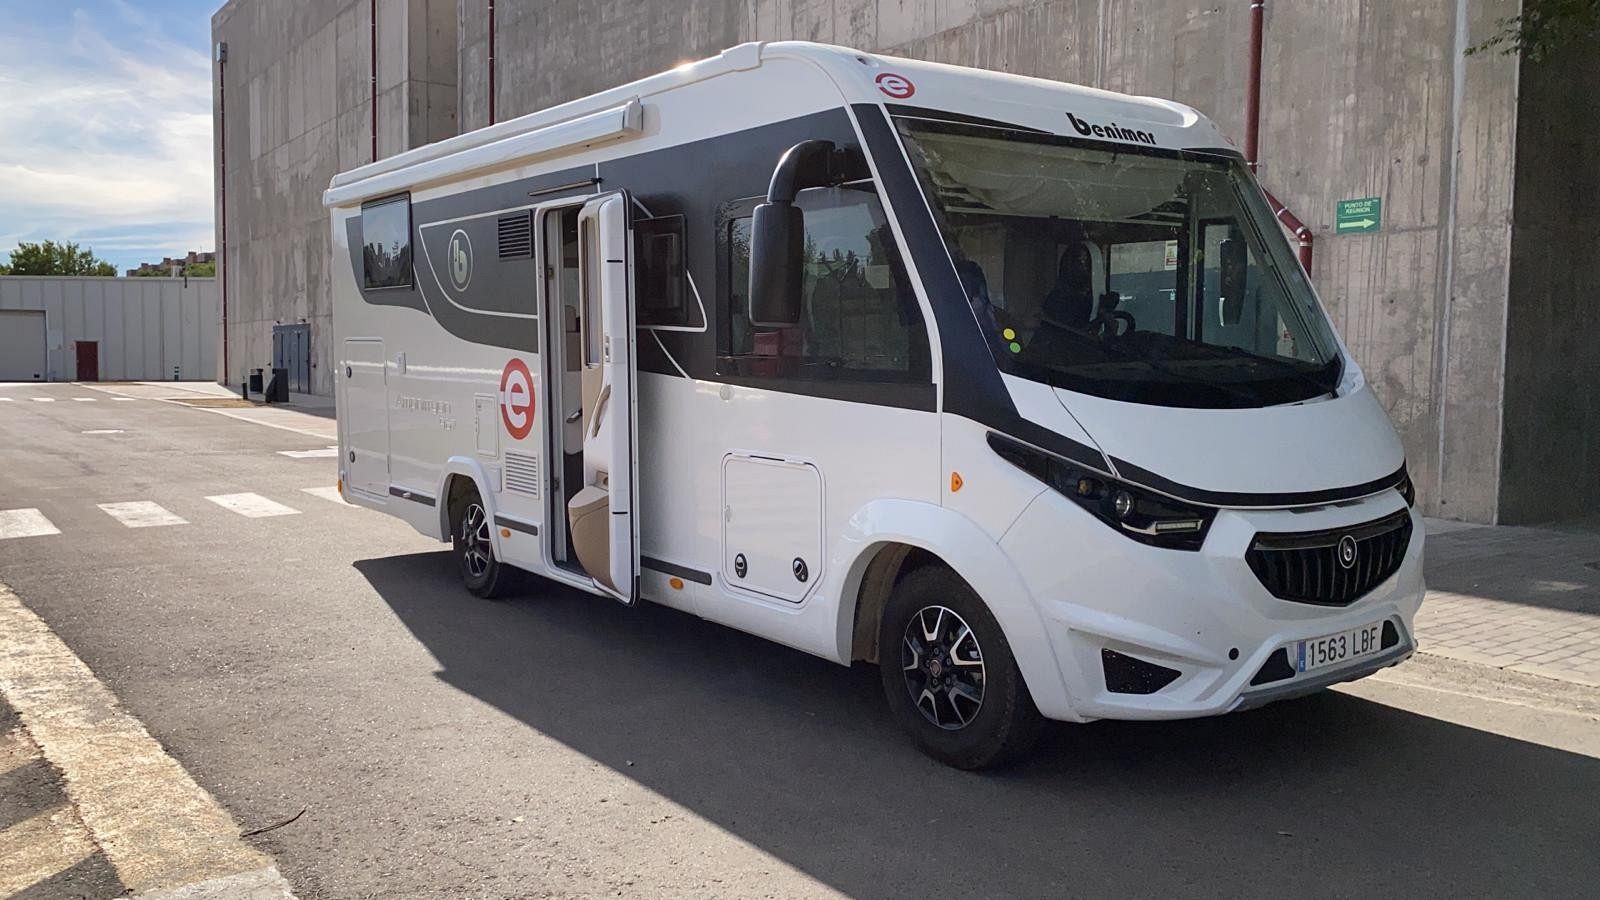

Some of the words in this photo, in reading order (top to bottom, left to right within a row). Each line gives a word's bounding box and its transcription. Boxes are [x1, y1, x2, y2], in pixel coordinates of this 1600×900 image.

[1065, 112, 1157, 145] benimar
[1309, 635, 1347, 666] 1563
[1352, 627, 1378, 655] LBF
